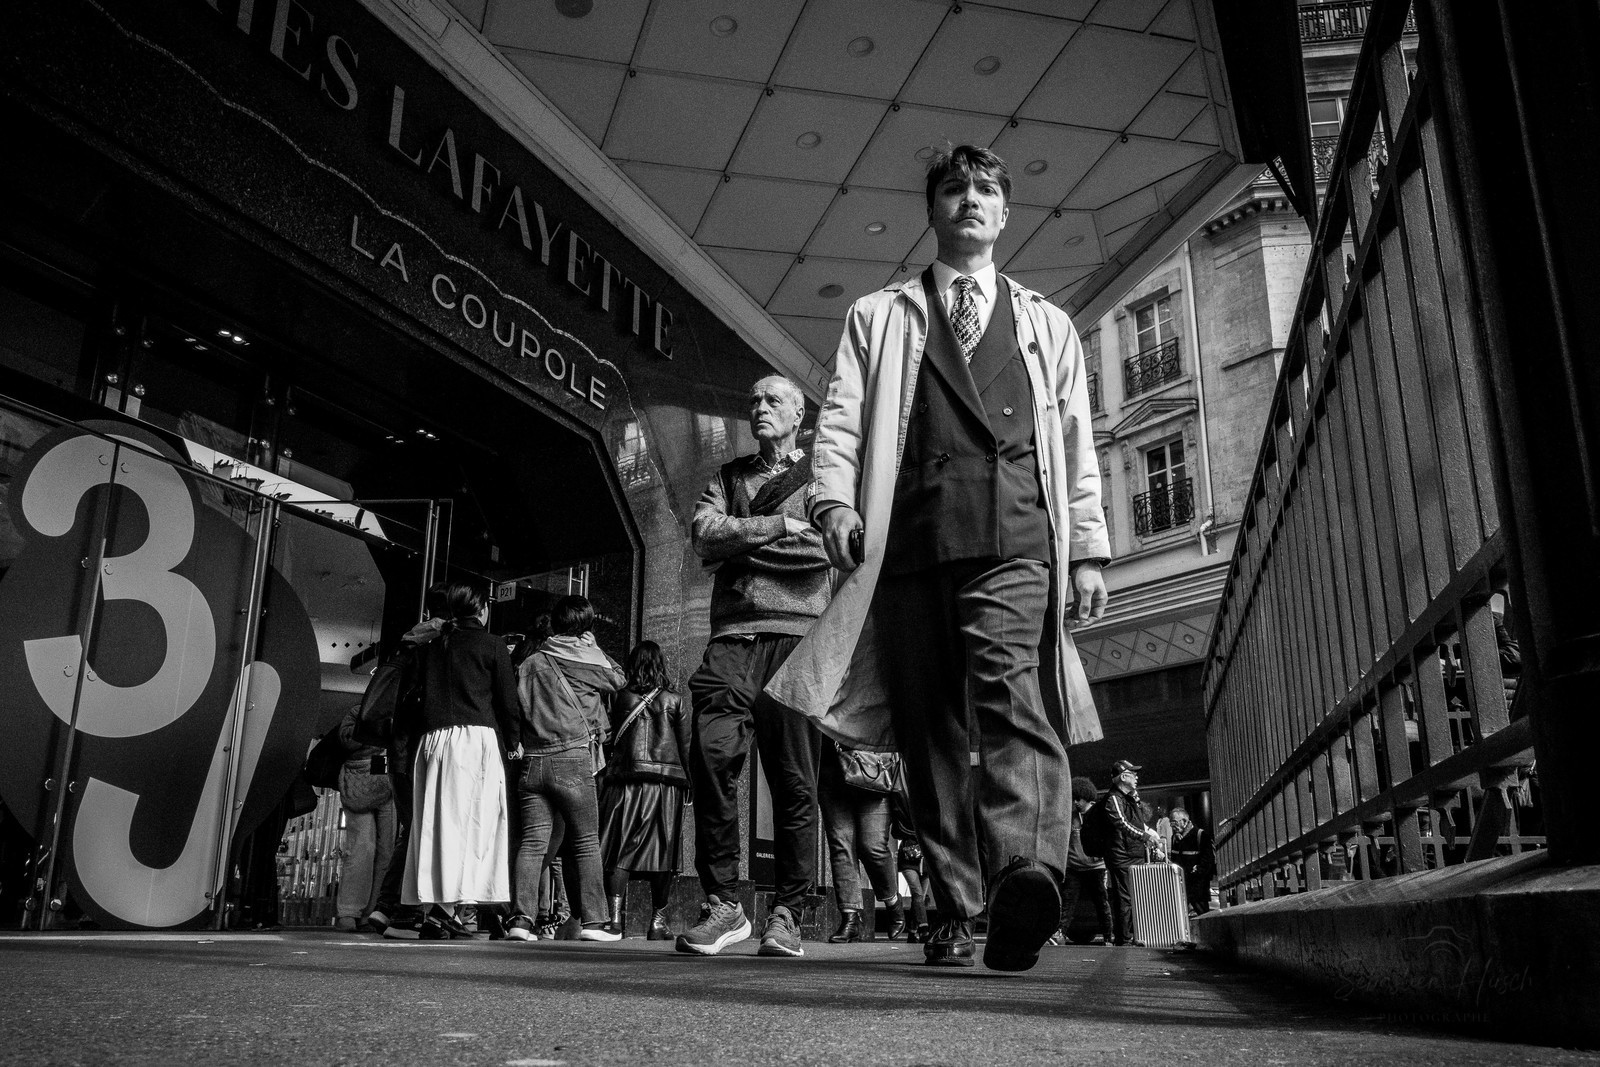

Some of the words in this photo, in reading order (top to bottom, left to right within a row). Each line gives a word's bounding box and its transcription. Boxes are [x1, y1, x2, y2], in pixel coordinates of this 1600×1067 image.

[205, 0, 359, 110] ES
[388, 84, 673, 360] LAFAYETTE
[351, 214, 409, 283] LA
[432, 273, 606, 410] COUPOLE
[501, 587, 512, 597] P21
